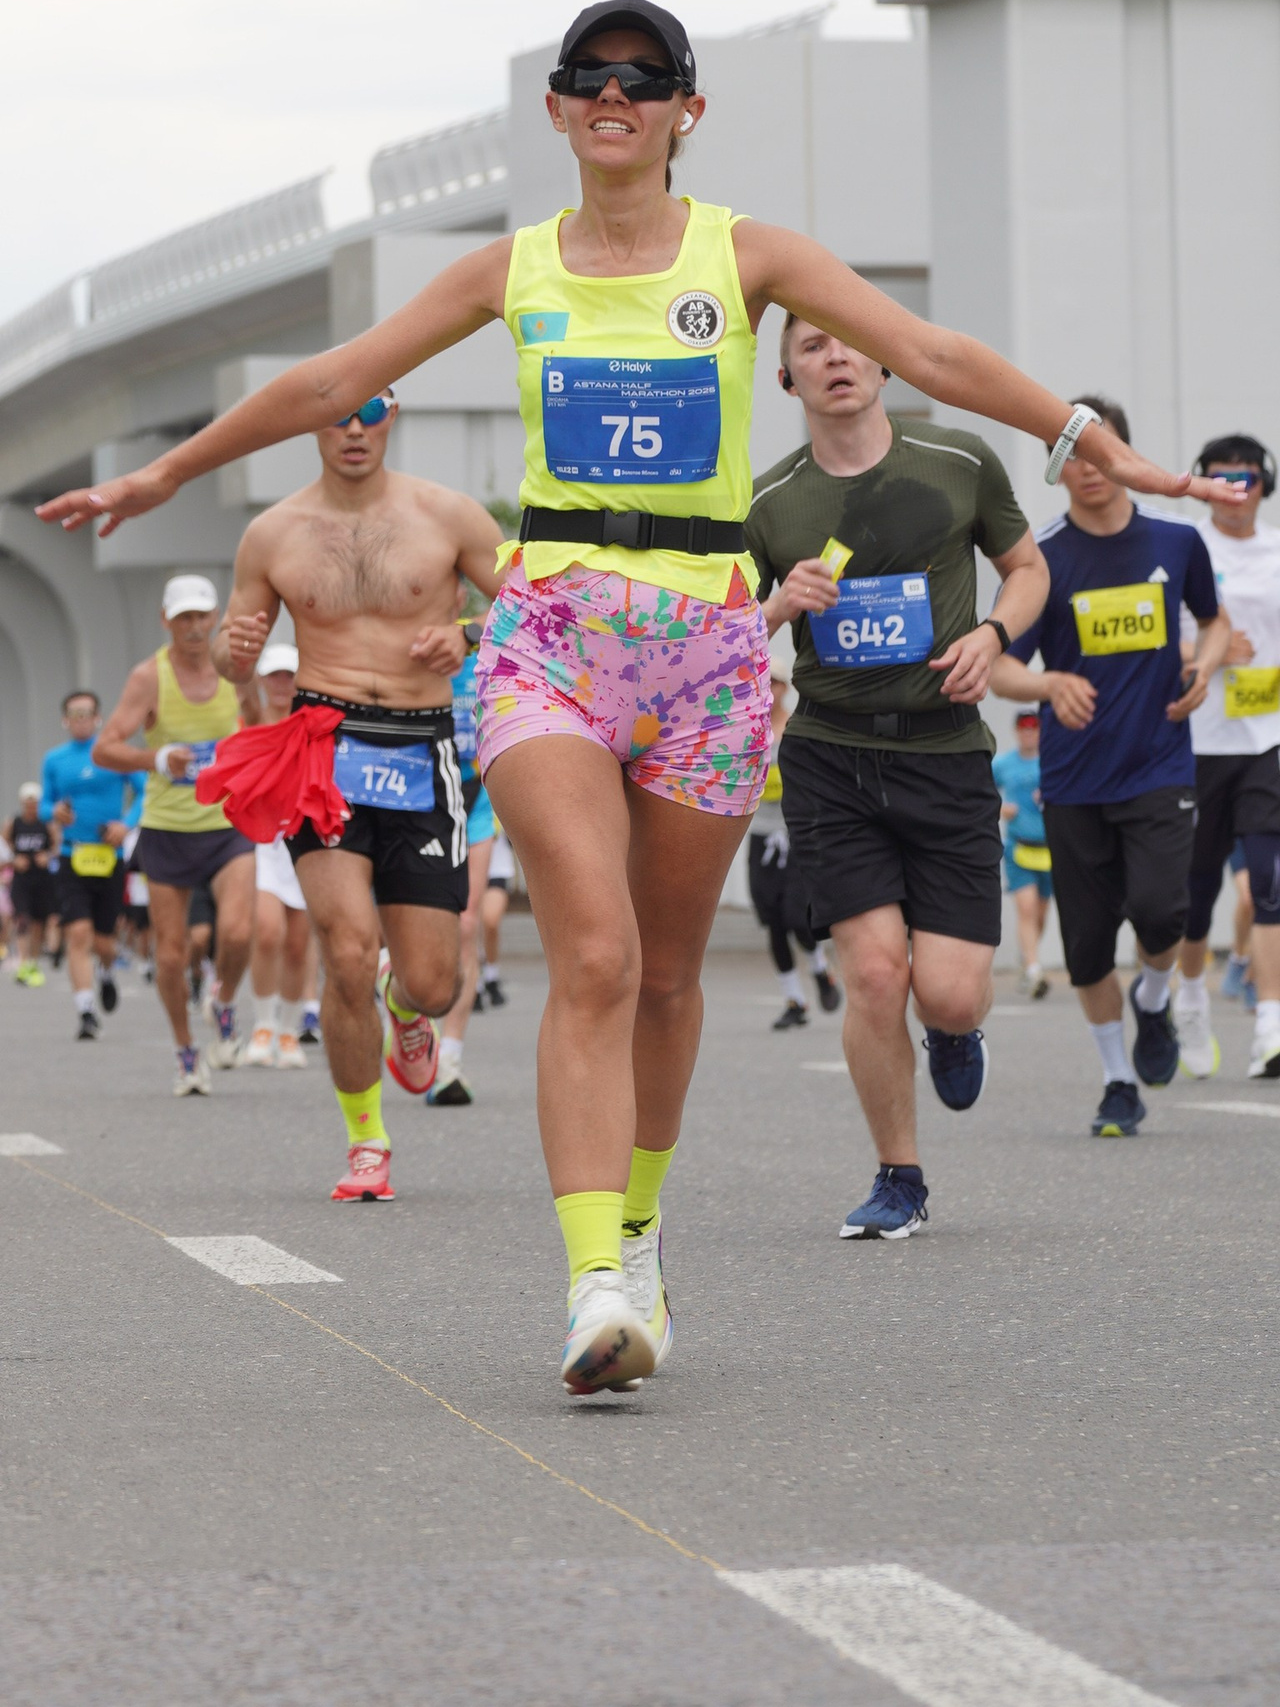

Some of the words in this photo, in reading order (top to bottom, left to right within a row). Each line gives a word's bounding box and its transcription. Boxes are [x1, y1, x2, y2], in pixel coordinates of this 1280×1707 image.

[688, 301, 705, 311] AB
[621, 361, 652, 374] Halyk
[548, 371, 565, 393] B
[573, 381, 619, 389] ASTANA
[621, 389, 686, 397] MARATHON
[601, 415, 663, 458] 75
[837, 614, 907, 650] 642
[1092, 614, 1155, 638] 4780
[361, 764, 407, 797] 174
